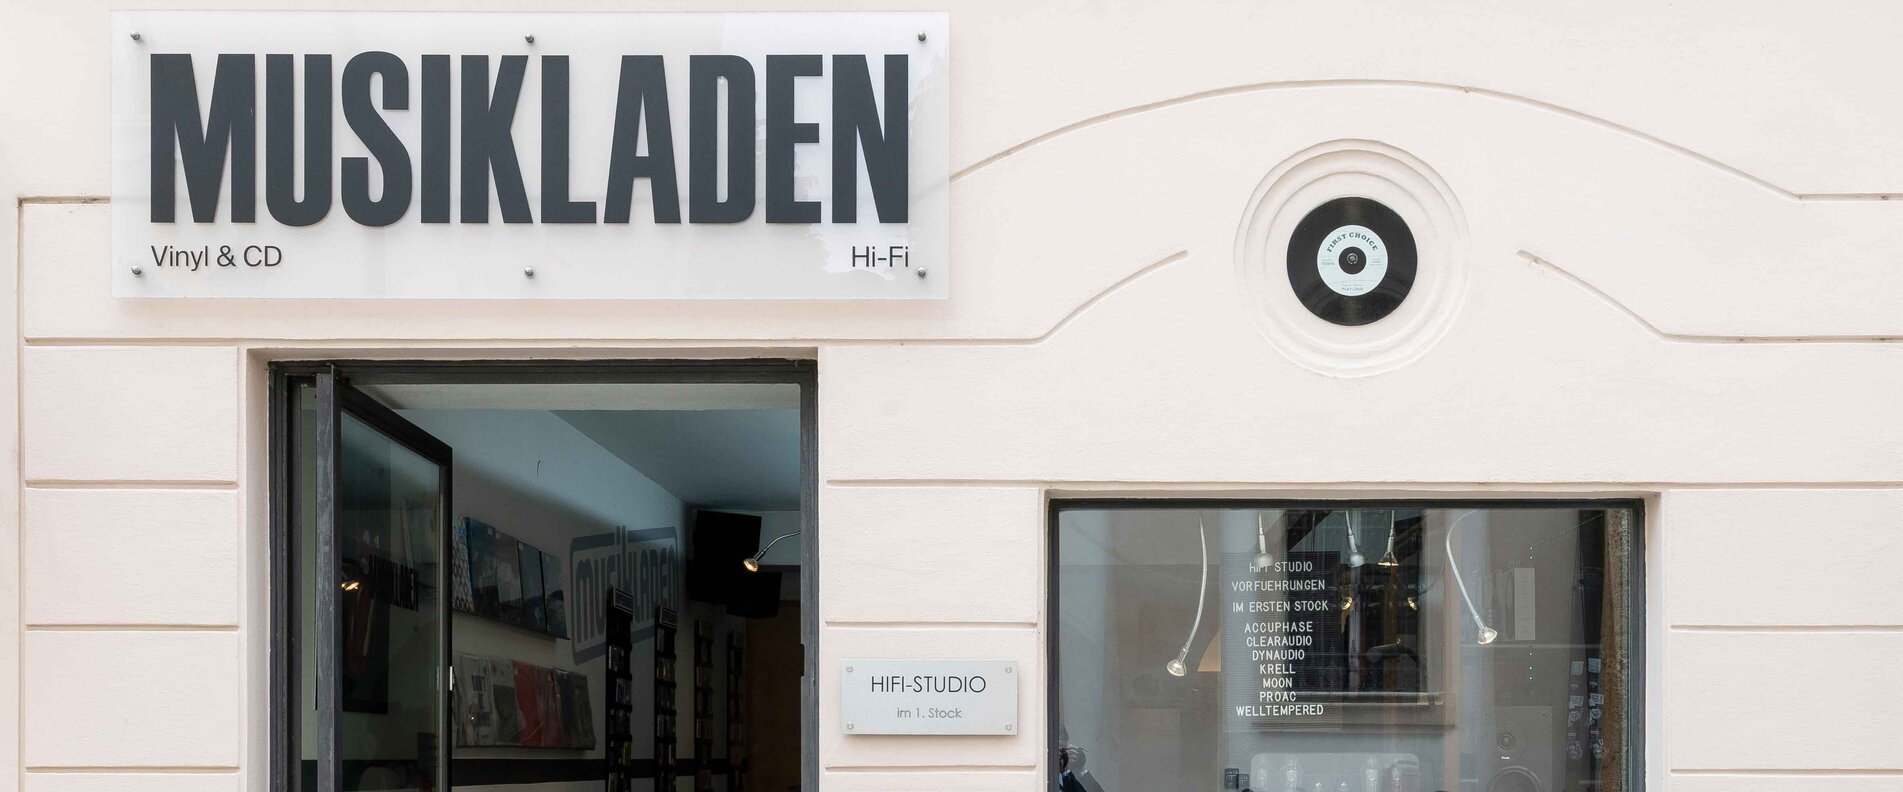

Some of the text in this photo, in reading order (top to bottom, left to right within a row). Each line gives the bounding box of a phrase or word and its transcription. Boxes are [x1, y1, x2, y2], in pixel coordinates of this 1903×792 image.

[150, 50, 909, 228] MUSIKLADEN
[1327, 232, 1378, 252] FIRST CHOICE
[150, 245, 282, 272] Vinyl & CD
[851, 245, 909, 268] Hi-Fi
[1274, 561, 1313, 573] STUDIO
[1232, 579, 1325, 592] VORFUEHRUNGEN
[1232, 600, 1329, 613] IM ERSTEN STOCK
[1244, 621, 1313, 633] ACCUPHASE
[1246, 635, 1313, 647] CLEARAUDIO
[1252, 649, 1305, 661] DYNAUDIO
[1259, 663, 1296, 674] KRELL
[871, 675, 987, 694] HIFI-STUDIO
[1262, 677, 1293, 688] MOON
[1259, 691, 1297, 702] PROAC
[896, 707, 962, 719] im 1. Stock
[1235, 704, 1324, 717] WELLTEMPERED
